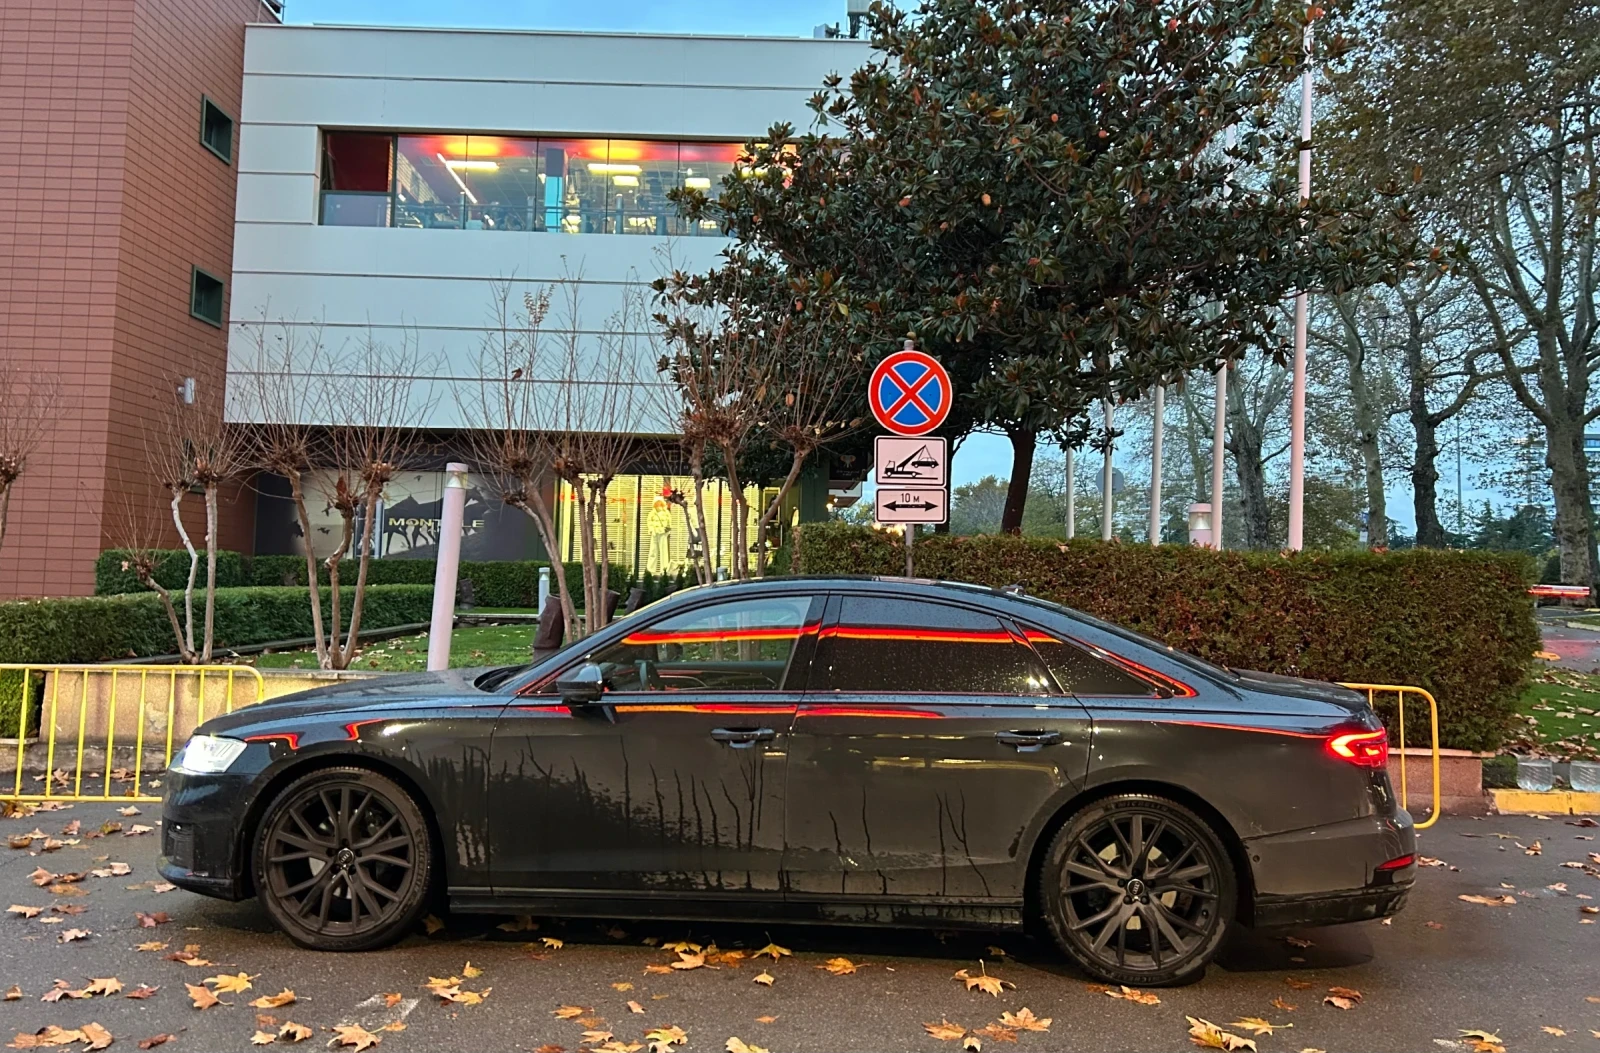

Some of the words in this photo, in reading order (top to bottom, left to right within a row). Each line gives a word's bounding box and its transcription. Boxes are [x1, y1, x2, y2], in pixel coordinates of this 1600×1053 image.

[901, 493, 911, 503] 10
[388, 517, 485, 528] MONTLE
[1117, 800, 1169, 812] MICHELIN
